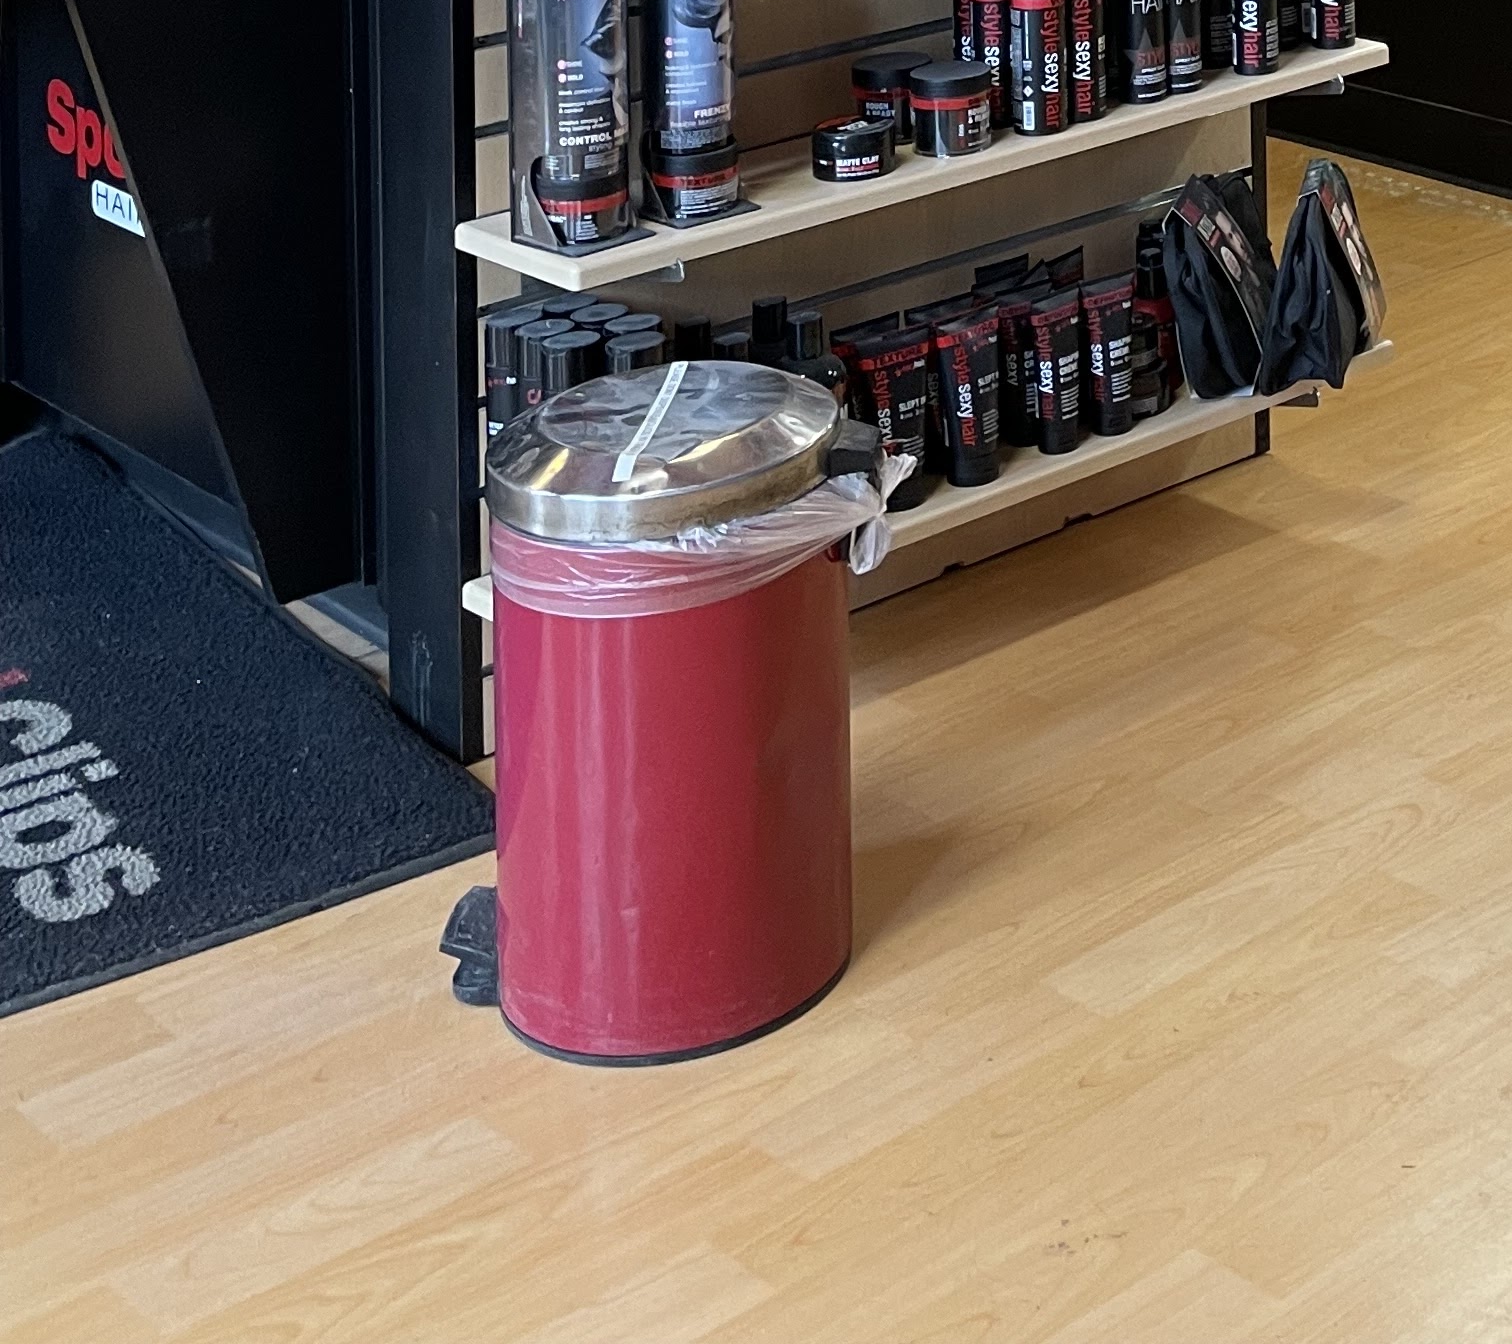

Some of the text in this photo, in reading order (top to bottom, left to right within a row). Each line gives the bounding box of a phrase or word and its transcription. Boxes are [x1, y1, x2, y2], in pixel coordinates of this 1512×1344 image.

[1040, 8, 1062, 129] stylesexyhair
[865, 101, 889, 110] ROUGH
[558, 132, 612, 148] CONTROL
[835, 154, 880, 168] MATTE CLAY
[679, 174, 728, 187] TEXTURE
[952, 345, 977, 447] stylesexyhair
